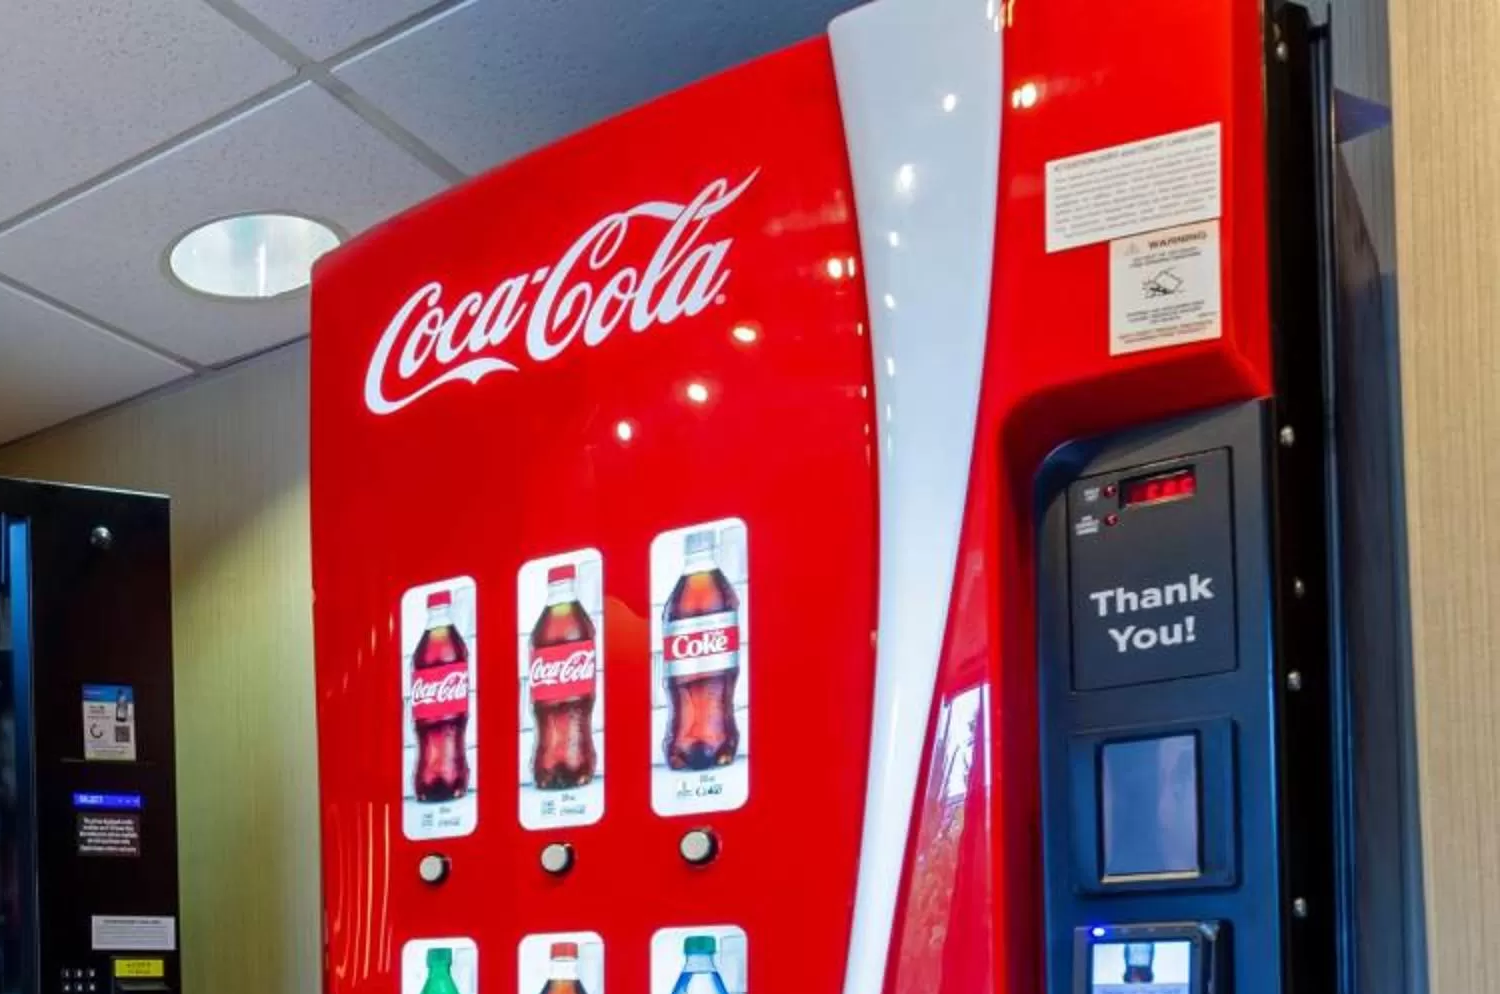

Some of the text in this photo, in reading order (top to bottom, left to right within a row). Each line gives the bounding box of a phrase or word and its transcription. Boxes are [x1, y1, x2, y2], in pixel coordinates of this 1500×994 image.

[364, 166, 762, 416] Coca-Cola
[1089, 573, 1215, 617] Thank
[672, 632, 729, 659] Coke
[1108, 616, 1197, 653] You!
[531, 650, 595, 687] Coca-Cola
[412, 671, 468, 707] Coca-Cola
